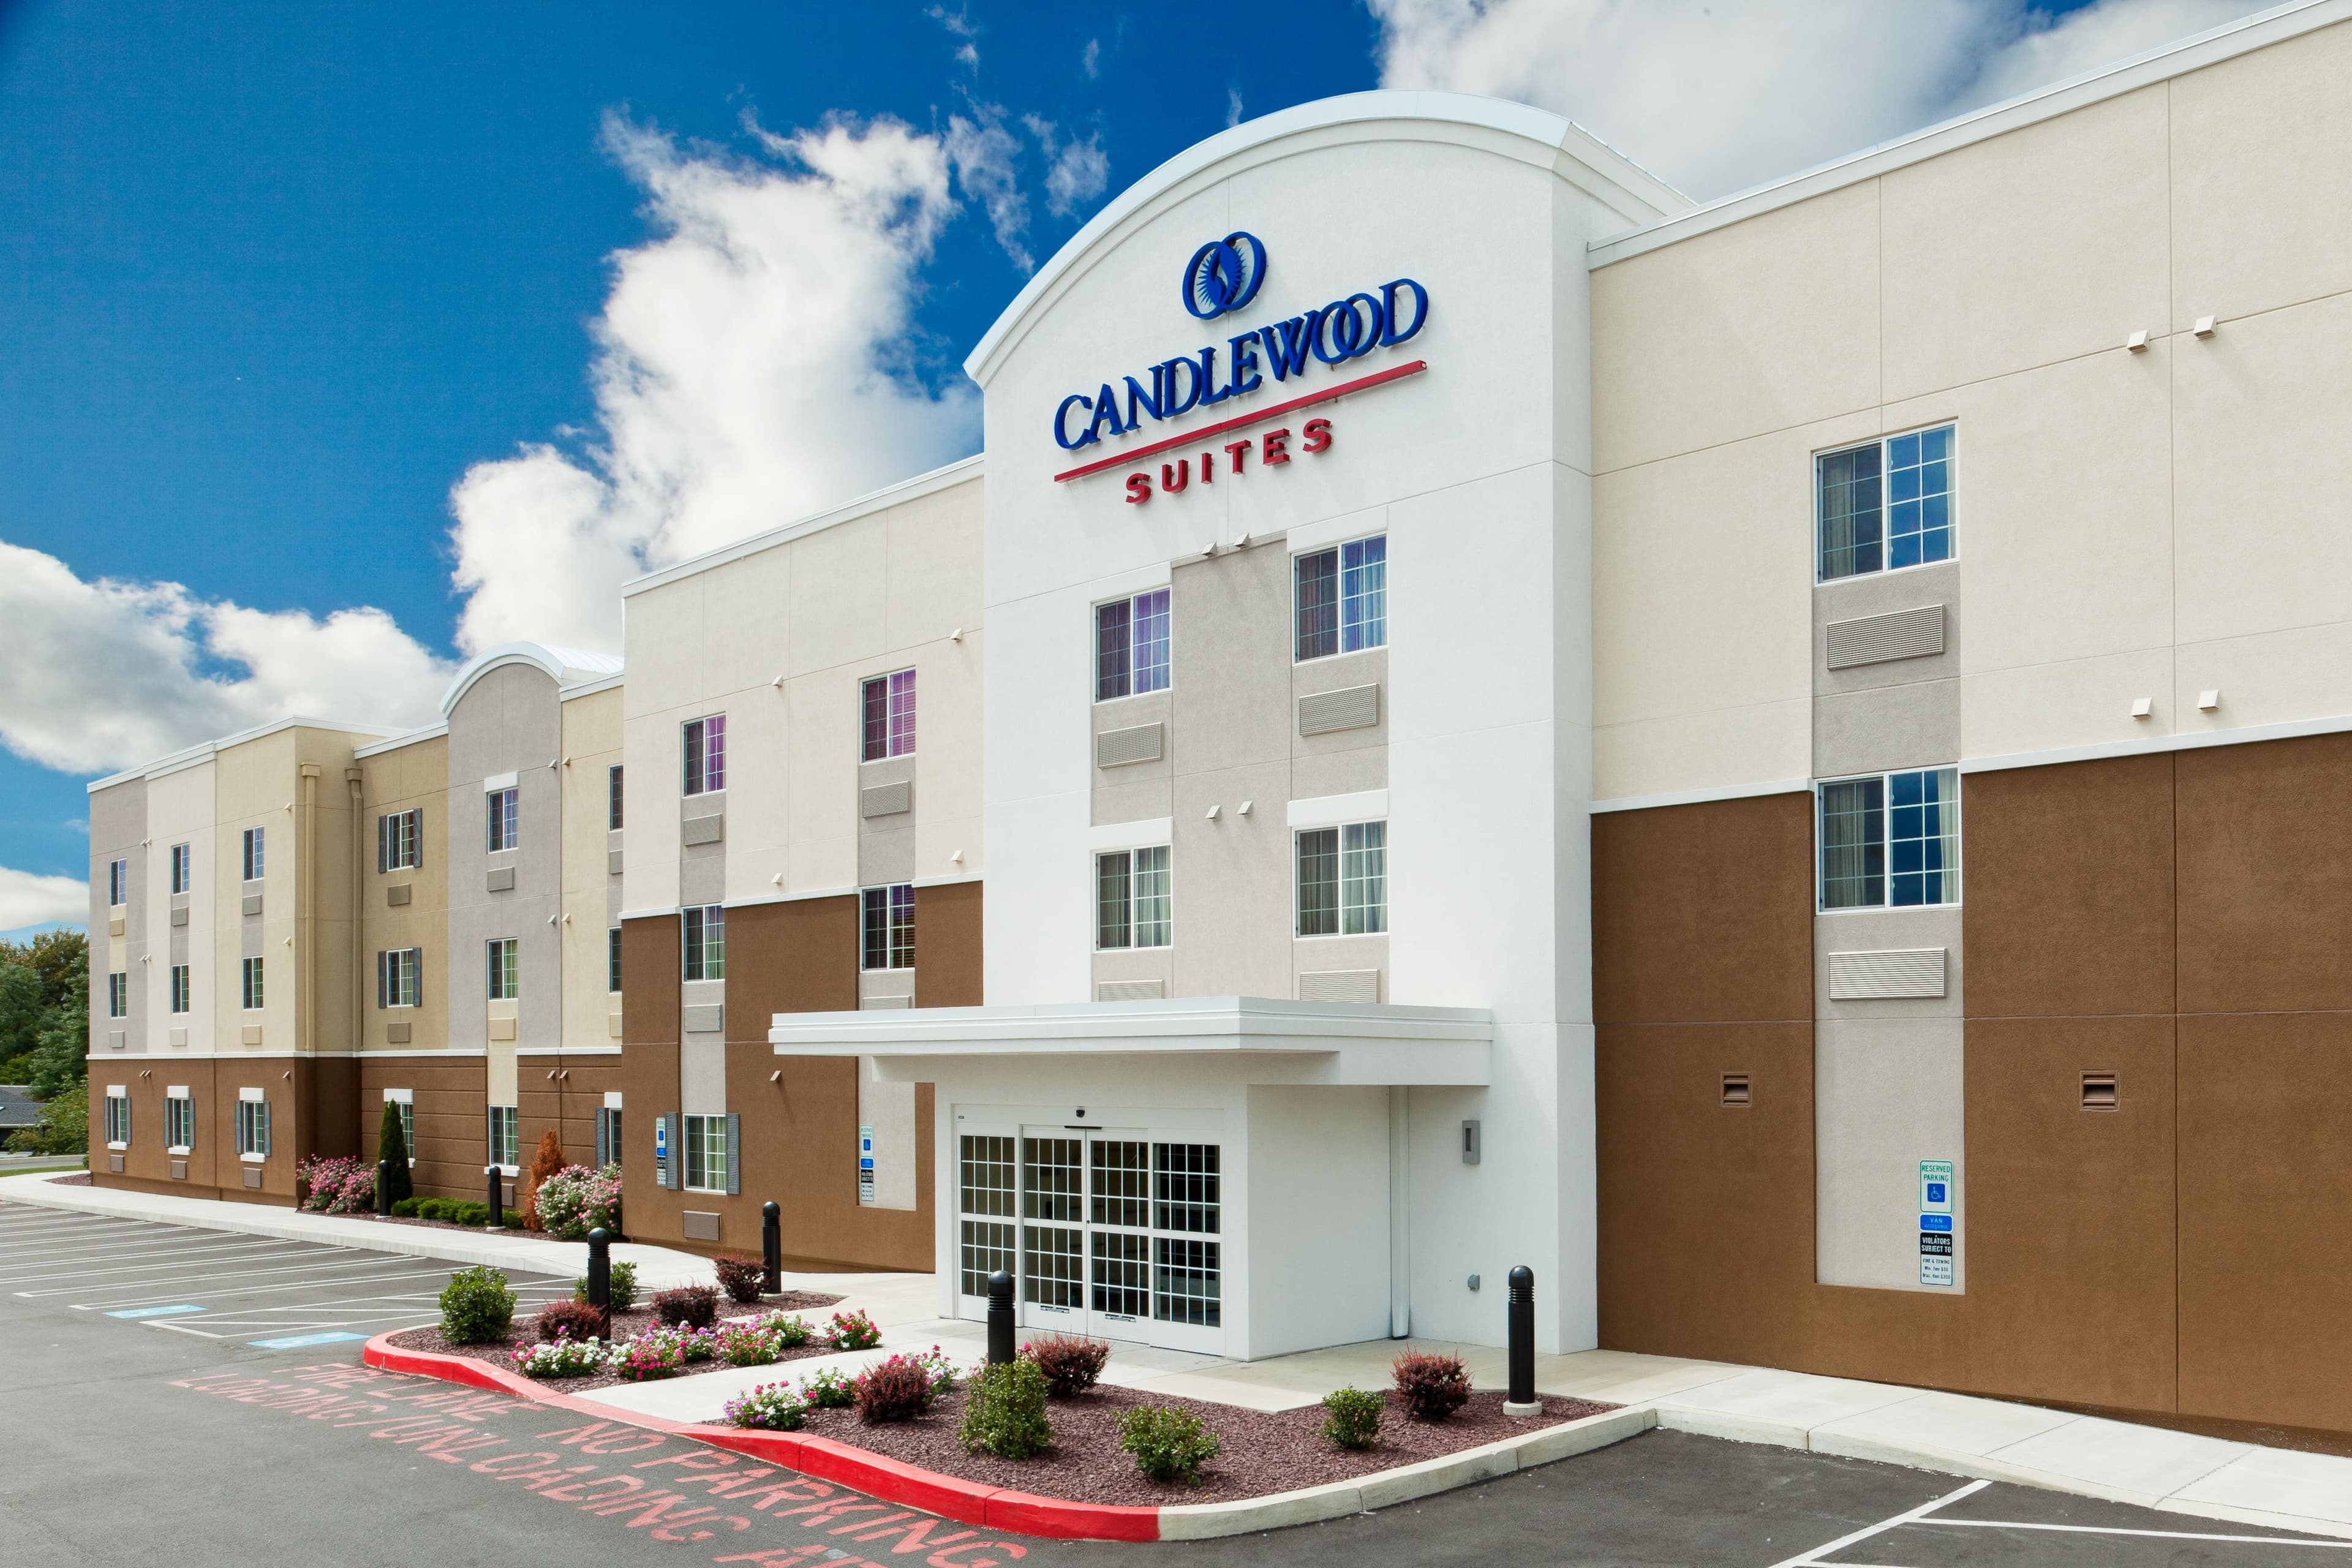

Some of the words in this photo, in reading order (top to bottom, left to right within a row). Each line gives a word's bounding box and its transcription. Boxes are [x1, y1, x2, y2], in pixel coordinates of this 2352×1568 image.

[1054, 278, 1428, 451] CANDLEWOOD
[1125, 418, 1332, 505] SUITES
[364, 1382, 549, 1422] LANE
[533, 1421, 666, 1454] NO
[630, 1449, 1028, 1568] PARKING
